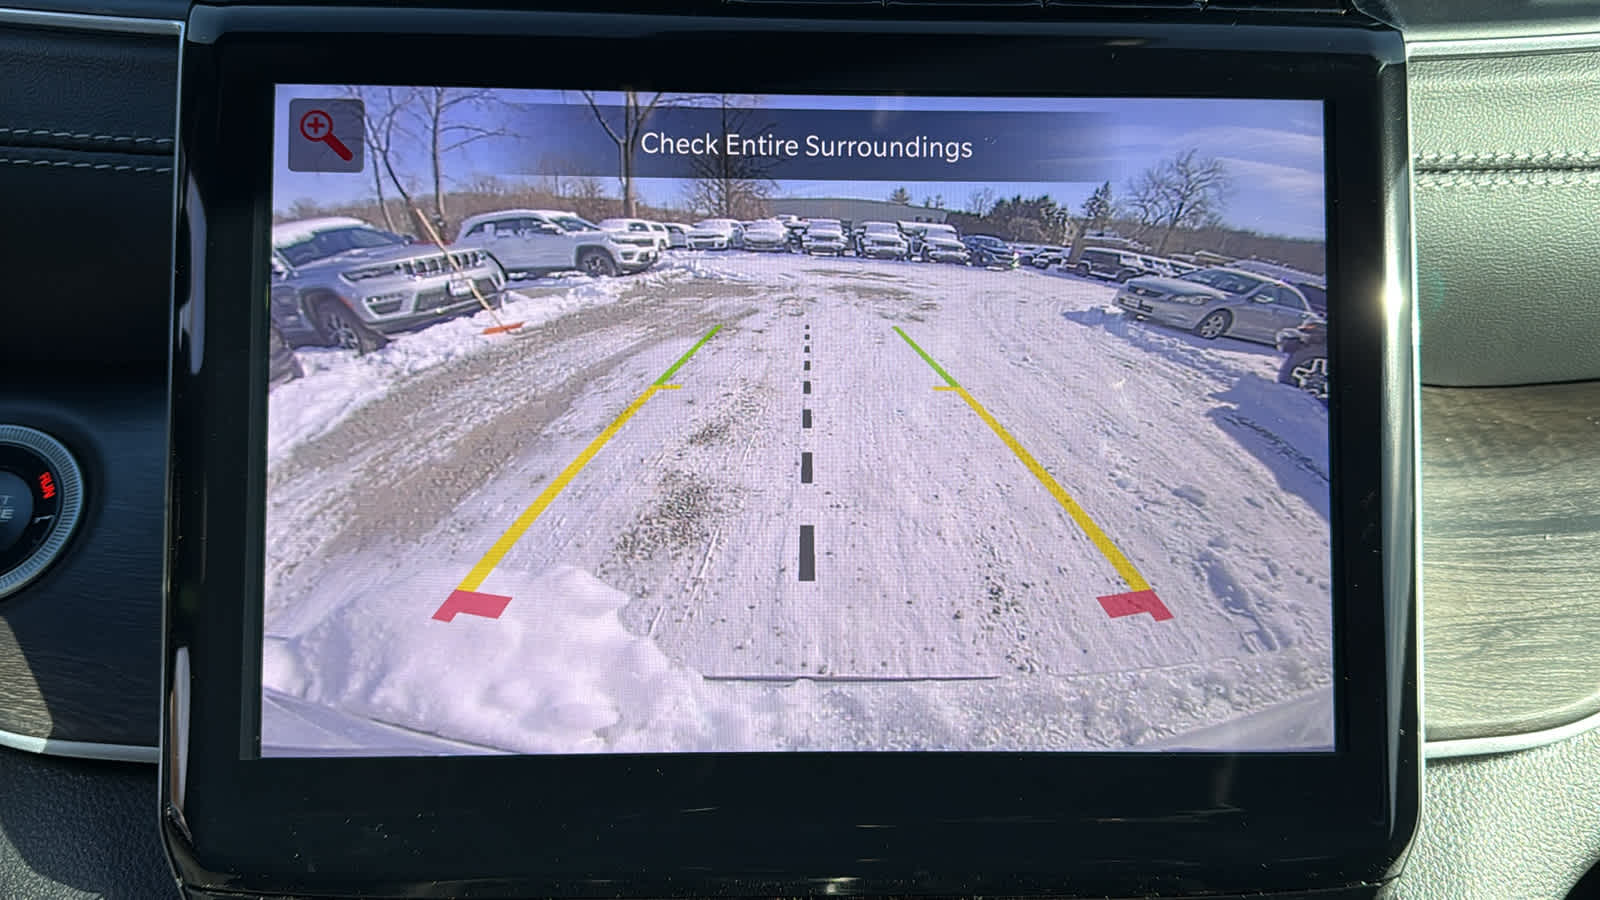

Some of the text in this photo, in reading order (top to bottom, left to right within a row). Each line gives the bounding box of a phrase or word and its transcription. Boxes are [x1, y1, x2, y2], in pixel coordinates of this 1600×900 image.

[641, 132, 973, 162] Check Entire Surroundings
[39, 471, 56, 498] RUN
